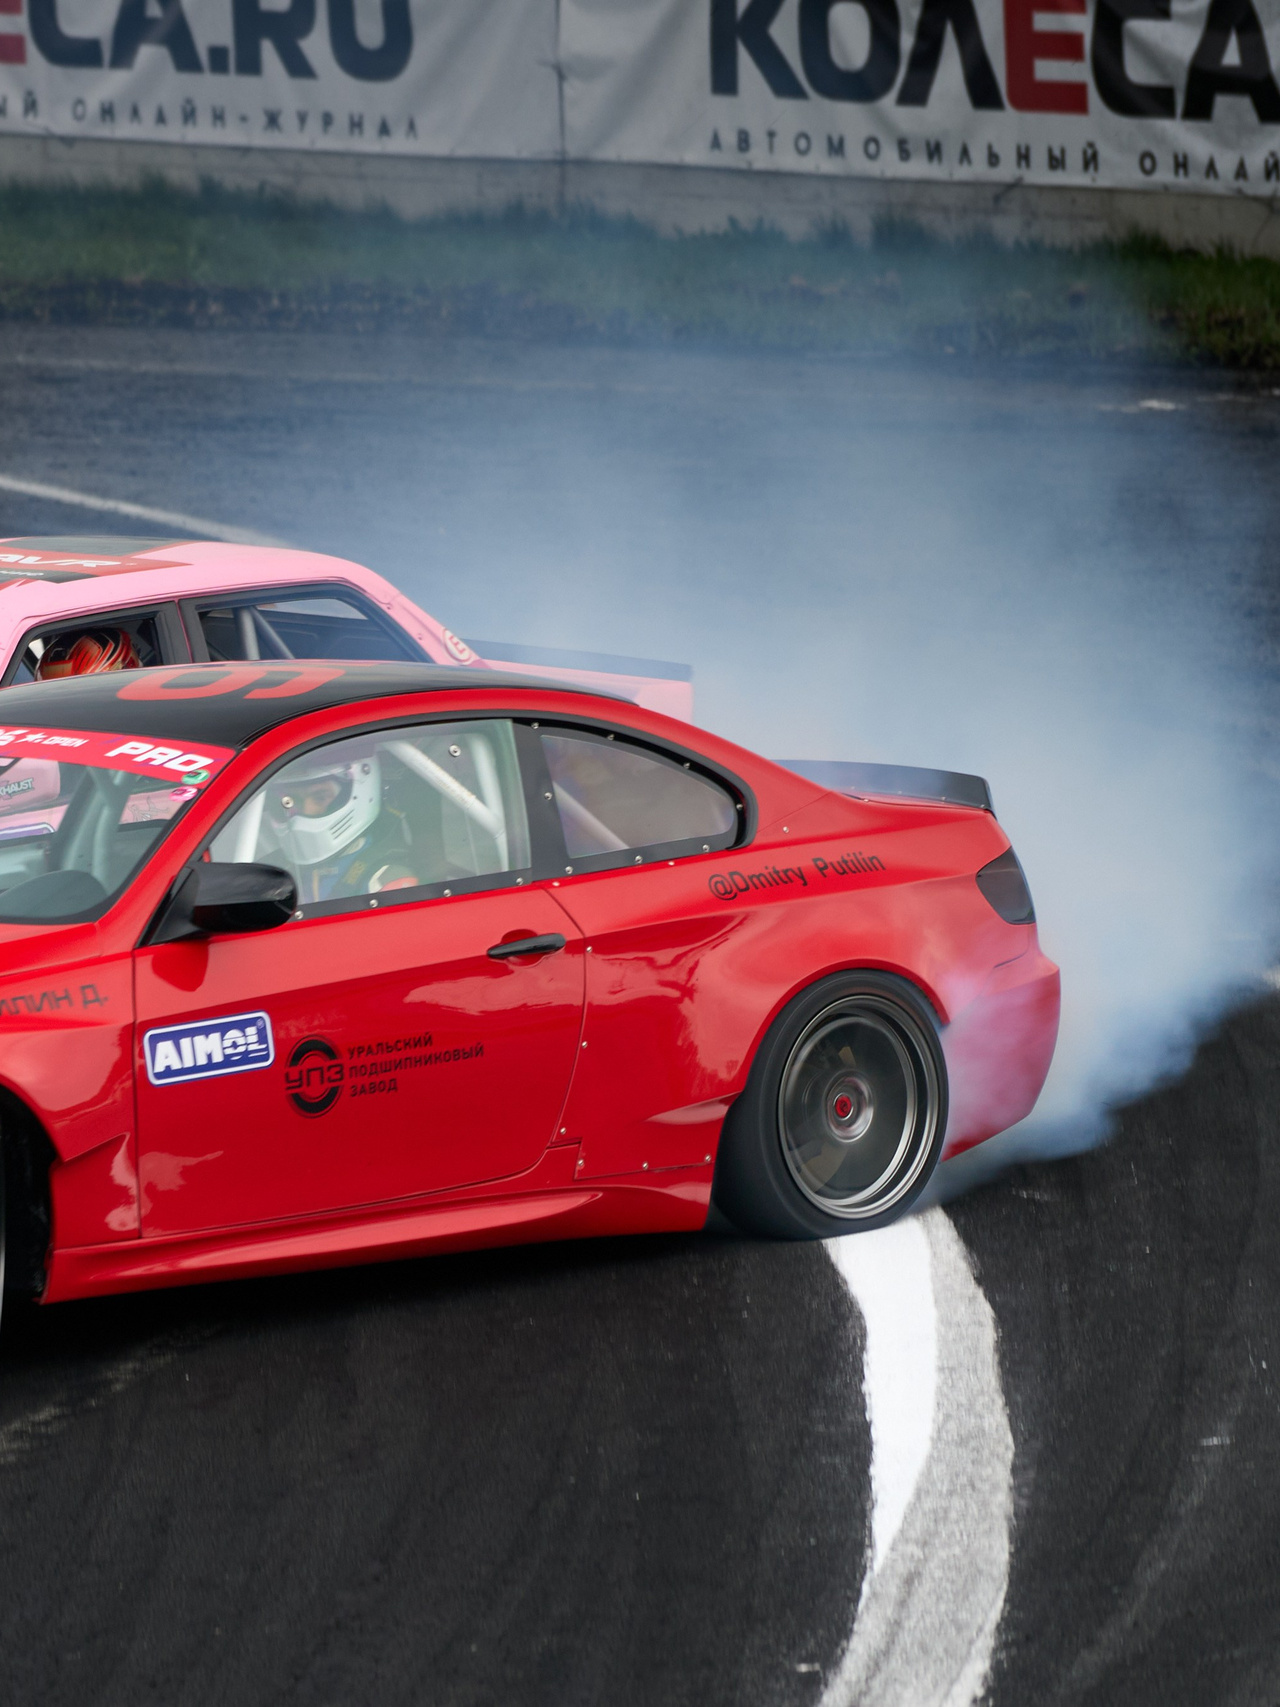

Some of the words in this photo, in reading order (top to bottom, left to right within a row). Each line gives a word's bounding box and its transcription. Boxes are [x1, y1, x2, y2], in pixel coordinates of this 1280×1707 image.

[72, 98, 420, 139] ОНЛАЙН-ЖУРНАЛ
[710, 128, 1100, 174] АВТОМОБИЛЬНЫЙ
[41, 735, 90, 749] OPEN
[104, 741, 215, 773] PRO
[708, 866, 808, 901] @Dmitry
[812, 851, 887, 878] Putilin
[79, 984, 109, 1009] Д.
[153, 1024, 268, 1074] AIMOL
[347, 1031, 434, 1060] УРАЛЬСКИЙ
[349, 1041, 486, 1079] ПОДШИПНИКОВЫЙ
[285, 1062, 345, 1093] УПЗ
[349, 1078, 399, 1098] ЗАВОД
